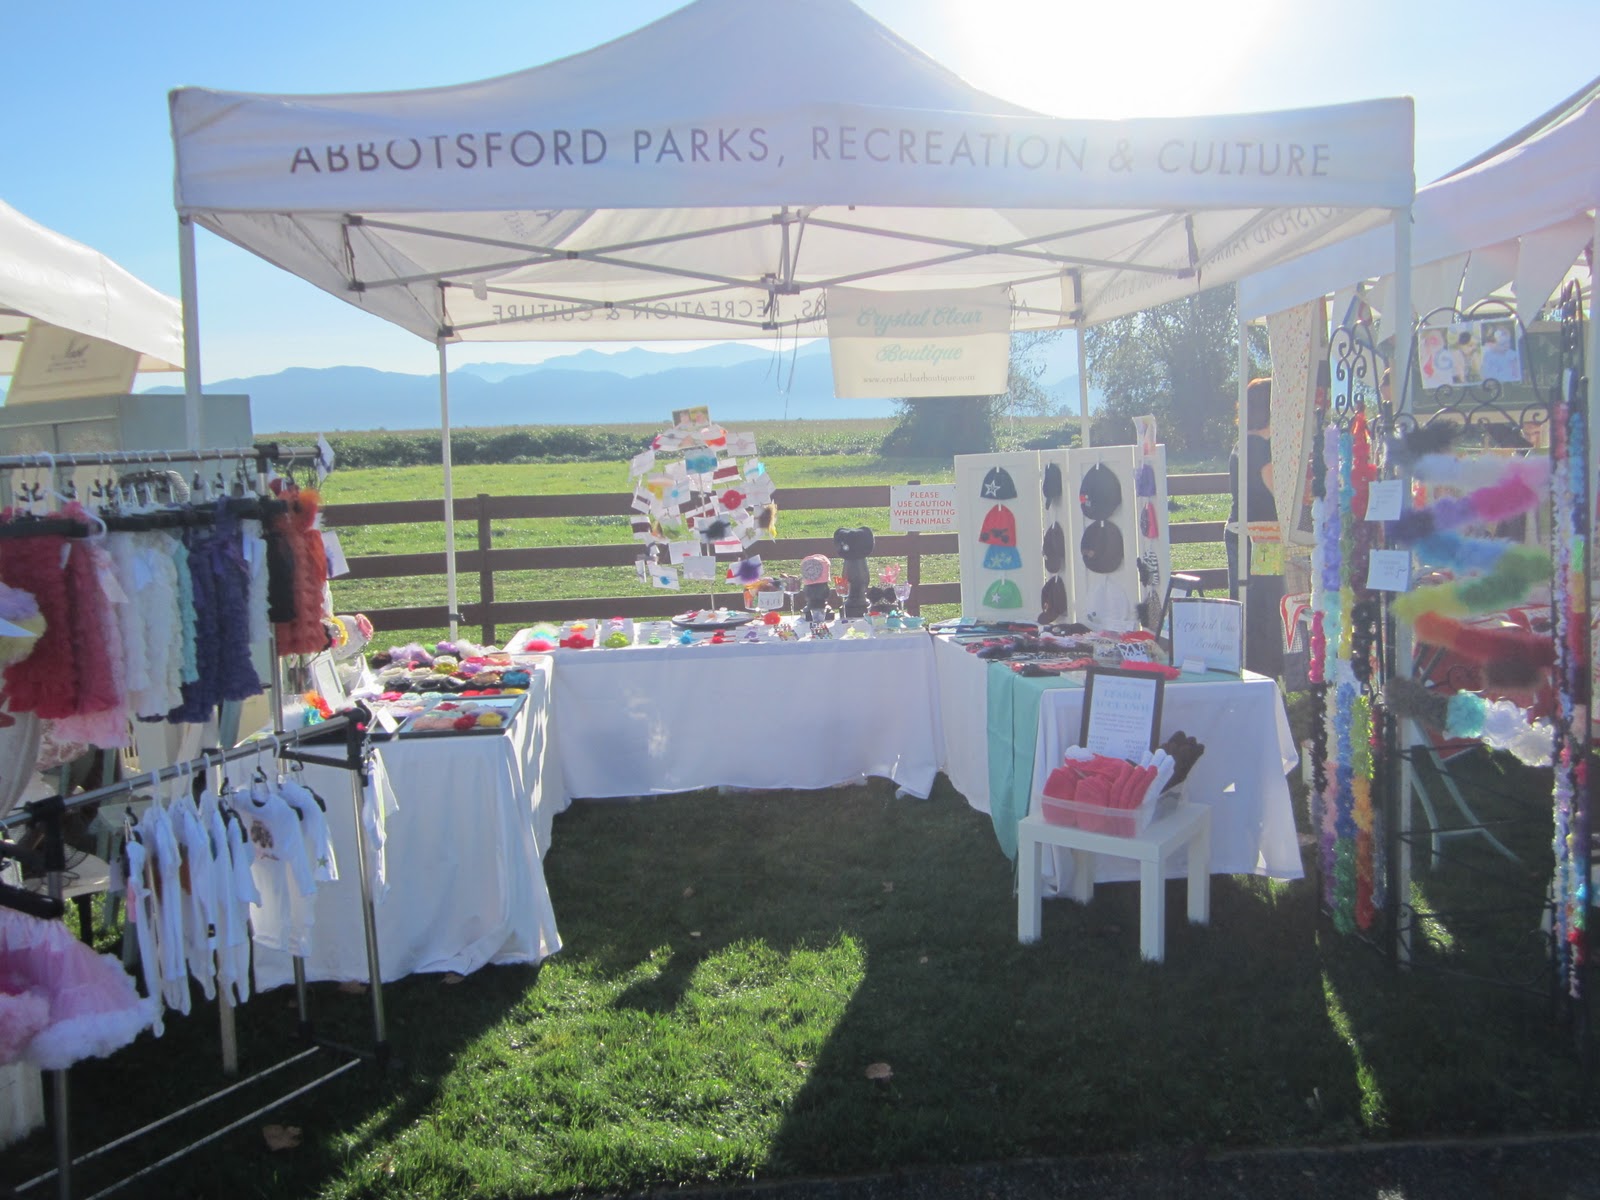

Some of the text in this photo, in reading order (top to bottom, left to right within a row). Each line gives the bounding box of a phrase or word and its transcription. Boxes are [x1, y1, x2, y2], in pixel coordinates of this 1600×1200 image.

[290, 124, 1331, 178] ABBOTSFORD PARKS, RECREATION & CULTURE
[857, 307, 930, 336] Crystal
[932, 307, 983, 325] Clear
[875, 344, 963, 366] Boutique
[910, 491, 940, 499] PLEASE
